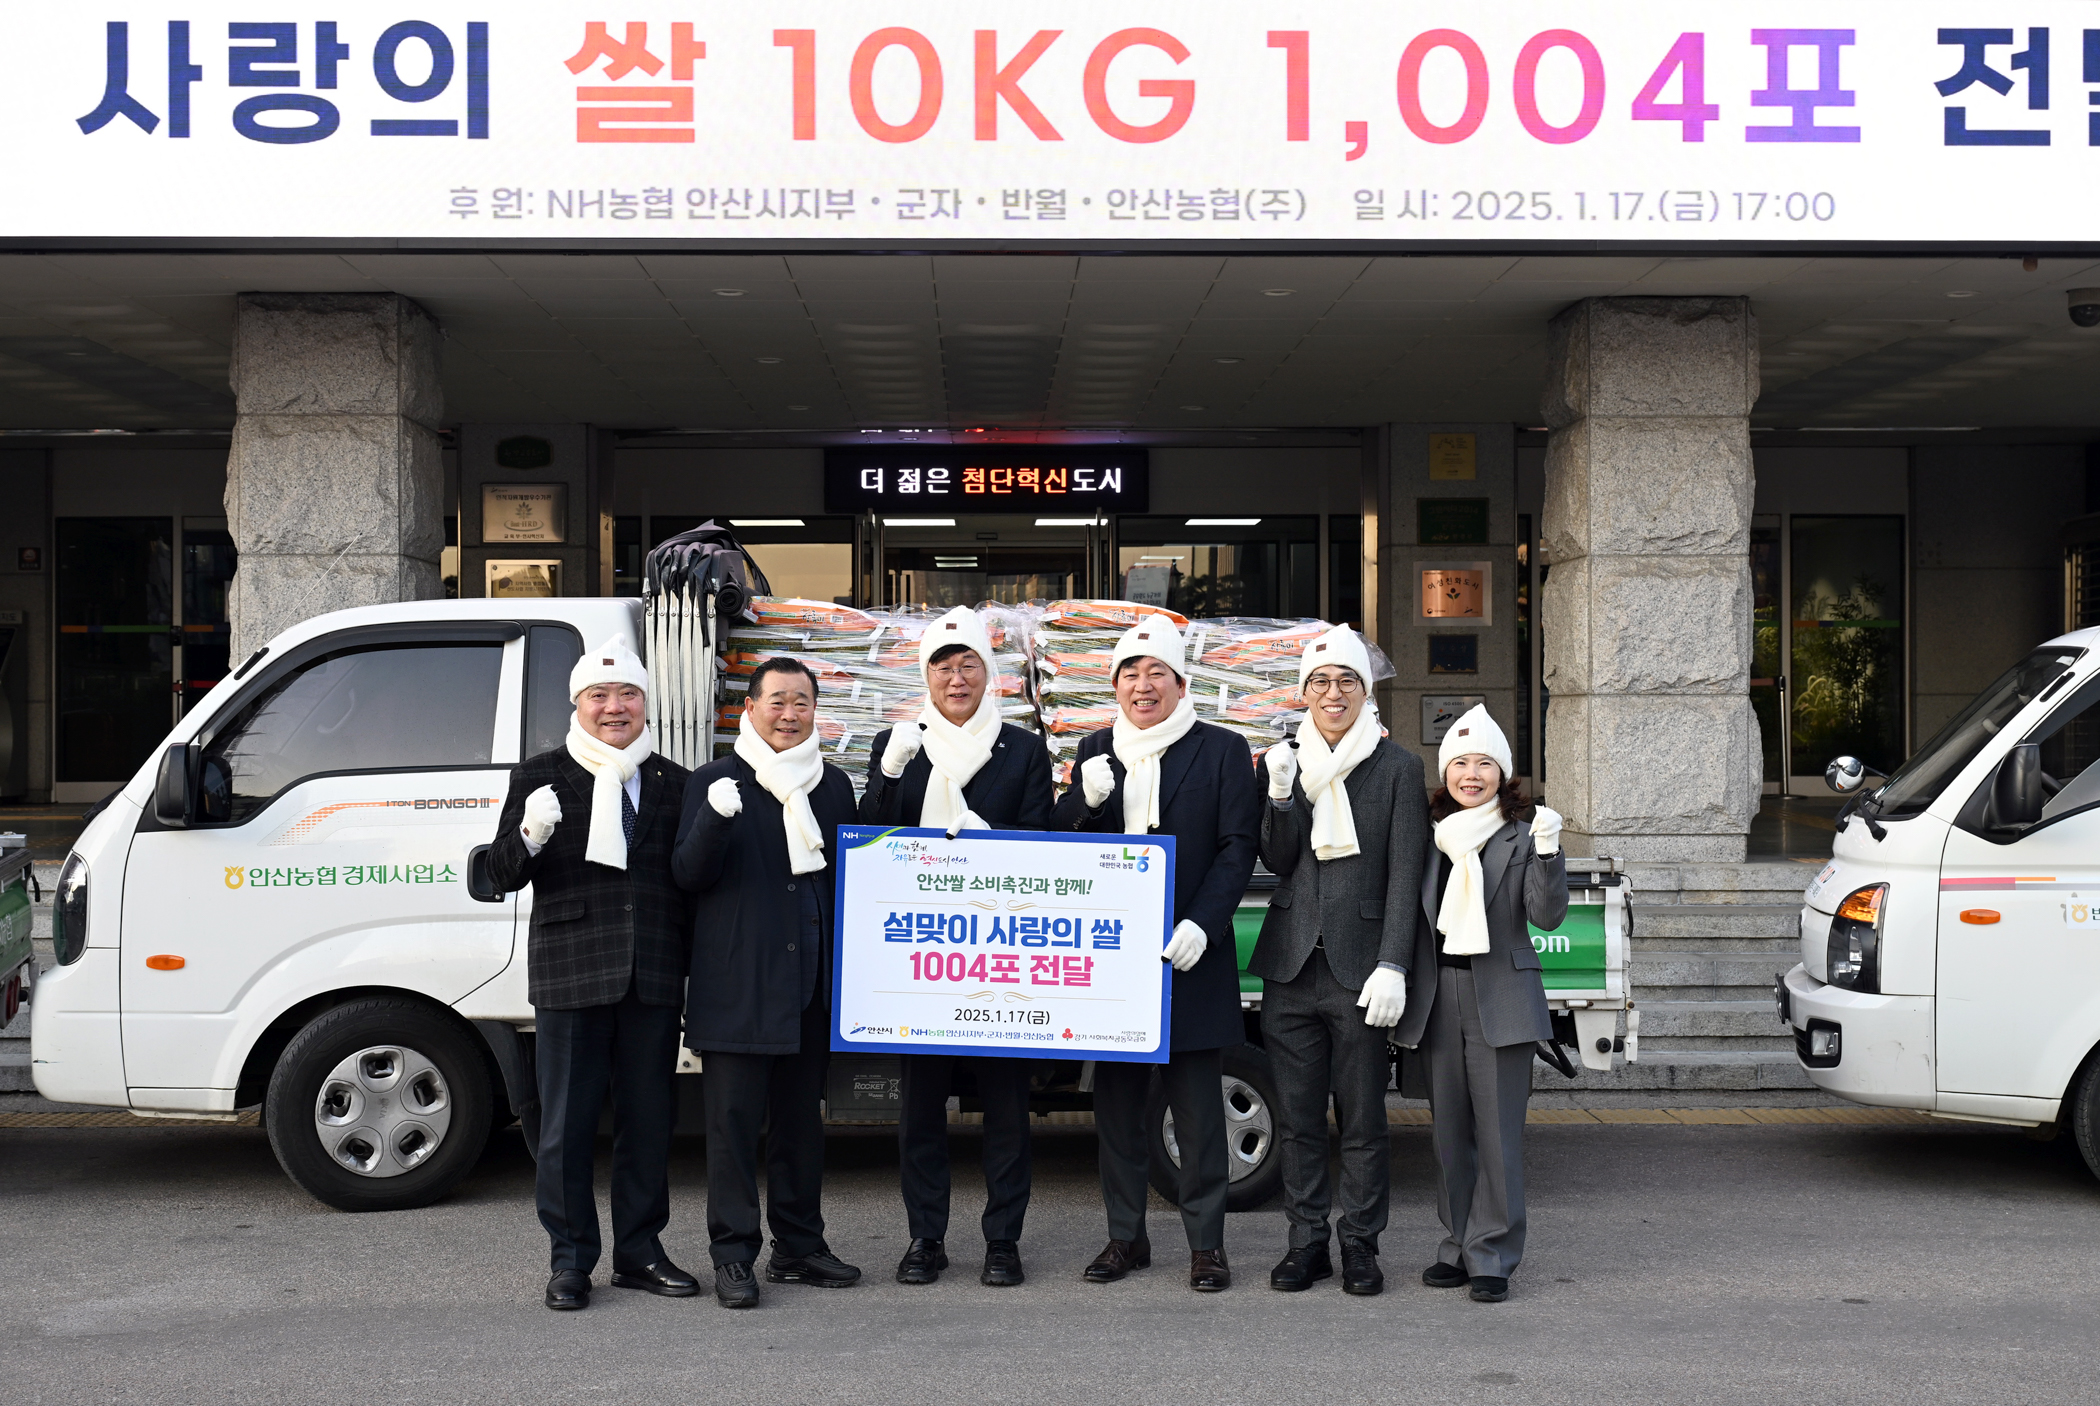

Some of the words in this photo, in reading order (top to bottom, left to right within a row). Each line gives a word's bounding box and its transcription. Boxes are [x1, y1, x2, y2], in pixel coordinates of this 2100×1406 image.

[78, 21, 490, 144] 사랑의
[564, 21, 707, 144] 쌀
[773, 27, 1195, 145] 10KG
[1267, 28, 1861, 162] 1,004포
[1936, 28, 2100, 147] 전
[449, 186, 479, 220] 후
[491, 188, 533, 220] 원:
[547, 188, 673, 220] NH농협
[686, 188, 856, 221] 안산시지부
[896, 188, 963, 220] 군자
[1002, 188, 1066, 221] 반월
[1106, 188, 1307, 221] 안산농협(주)
[1354, 189, 1384, 221] 일
[1397, 190, 1438, 221] 시:
[1732, 192, 1835, 222] 17:00
[860, 467, 884, 494] 더
[897, 467, 951, 494] 젊은
[961, 467, 1122, 494] 첨단혁신도시
[1427, 577, 1479, 590] 여성친화도시
[414, 798, 478, 810] BONGO
[842, 831, 859, 840] NH
[1099, 853, 1117, 861] 새로운
[1099, 862, 1121, 870] 대한민국
[1122, 862, 1134, 870] 농협
[249, 865, 337, 887] 안산농협
[342, 863, 458, 886] 경제사업소
[916, 873, 965, 892] 안산쌀
[969, 875, 1050, 895] 소비촉진과
[1054, 877, 1093, 896] 함께!
[883, 911, 978, 945] 설맞이
[986, 914, 1082, 949] 사랑의
[1090, 918, 1124, 950] 쌀
[909, 951, 1021, 984] 1004포
[1029, 954, 1095, 987] 전달
[954, 1007, 1051, 1025] 2025.1.17(금)
[867, 1026, 893, 1035] 안산시
[910, 1028, 945, 1037] NH농협
[854, 1082, 885, 1090] ROCKET
[889, 1092, 899, 1100] Pb
